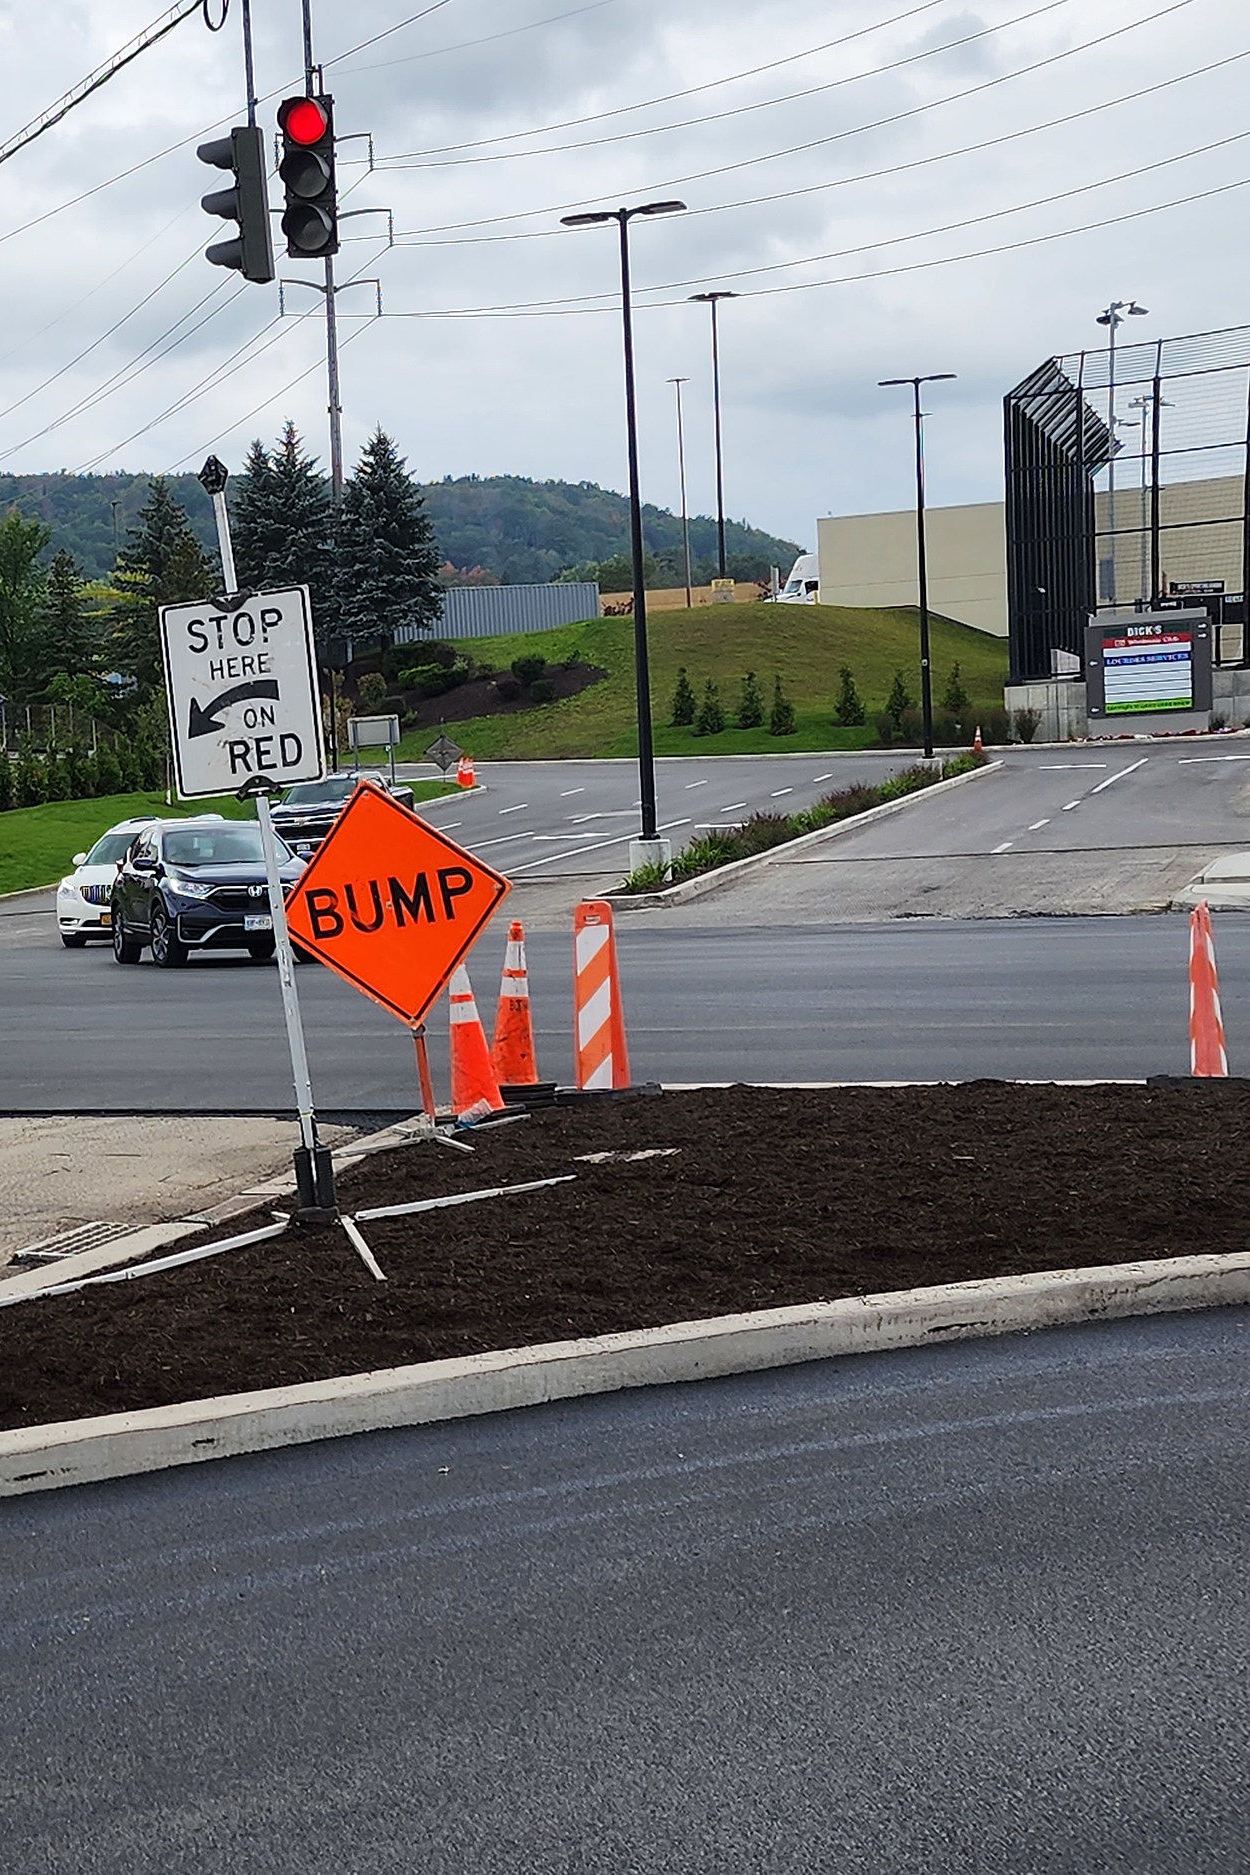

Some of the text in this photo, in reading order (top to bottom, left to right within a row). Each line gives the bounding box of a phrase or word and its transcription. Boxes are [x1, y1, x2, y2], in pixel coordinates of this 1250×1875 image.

[187, 608, 284, 654] STOP
[210, 653, 271, 681] HERE
[243, 705, 276, 729] ON
[228, 732, 303, 775] RED
[305, 866, 474, 940] BUMP
